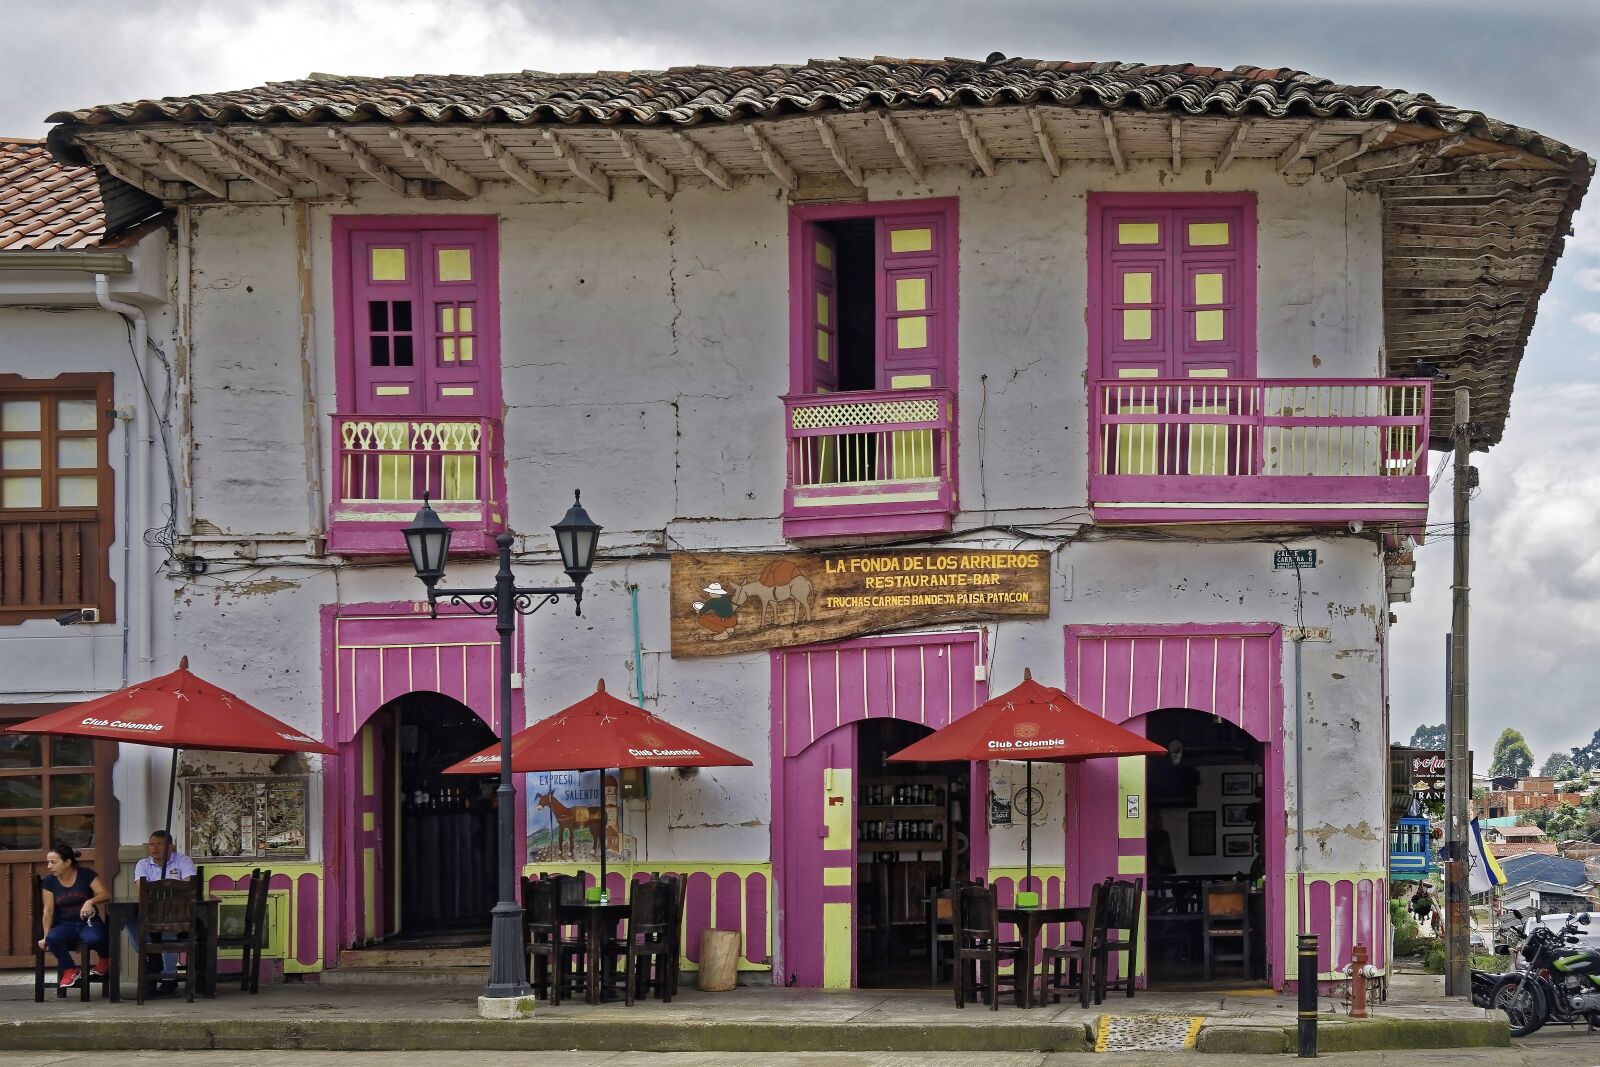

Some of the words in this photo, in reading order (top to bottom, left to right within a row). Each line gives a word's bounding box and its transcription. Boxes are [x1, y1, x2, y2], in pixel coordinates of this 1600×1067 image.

[825, 559, 846, 573] LA
[850, 557, 900, 573] FONDA
[903, 556, 923, 571] DE
[926, 555, 958, 570] LOS
[960, 554, 1039, 569] ARRIEROS
[865, 573, 1001, 589] RESTAURANTE-BAR
[826, 596, 871, 608] TRUCHAS
[872, 595, 910, 607] CARNES
[911, 594, 956, 606] BANDEJA
[956, 593, 985, 605] PAISA
[987, 591, 1029, 603] PATACON
[81, 717, 109, 726] Club
[110, 720, 164, 731] Colombia
[988, 740, 1013, 748] Club
[1014, 738, 1065, 748] Colombia
[628, 748, 653, 756] Club
[652, 748, 701, 756] Colombia
[539, 774, 573, 786] EXPRESO
[565, 789, 599, 801] SALENTO
